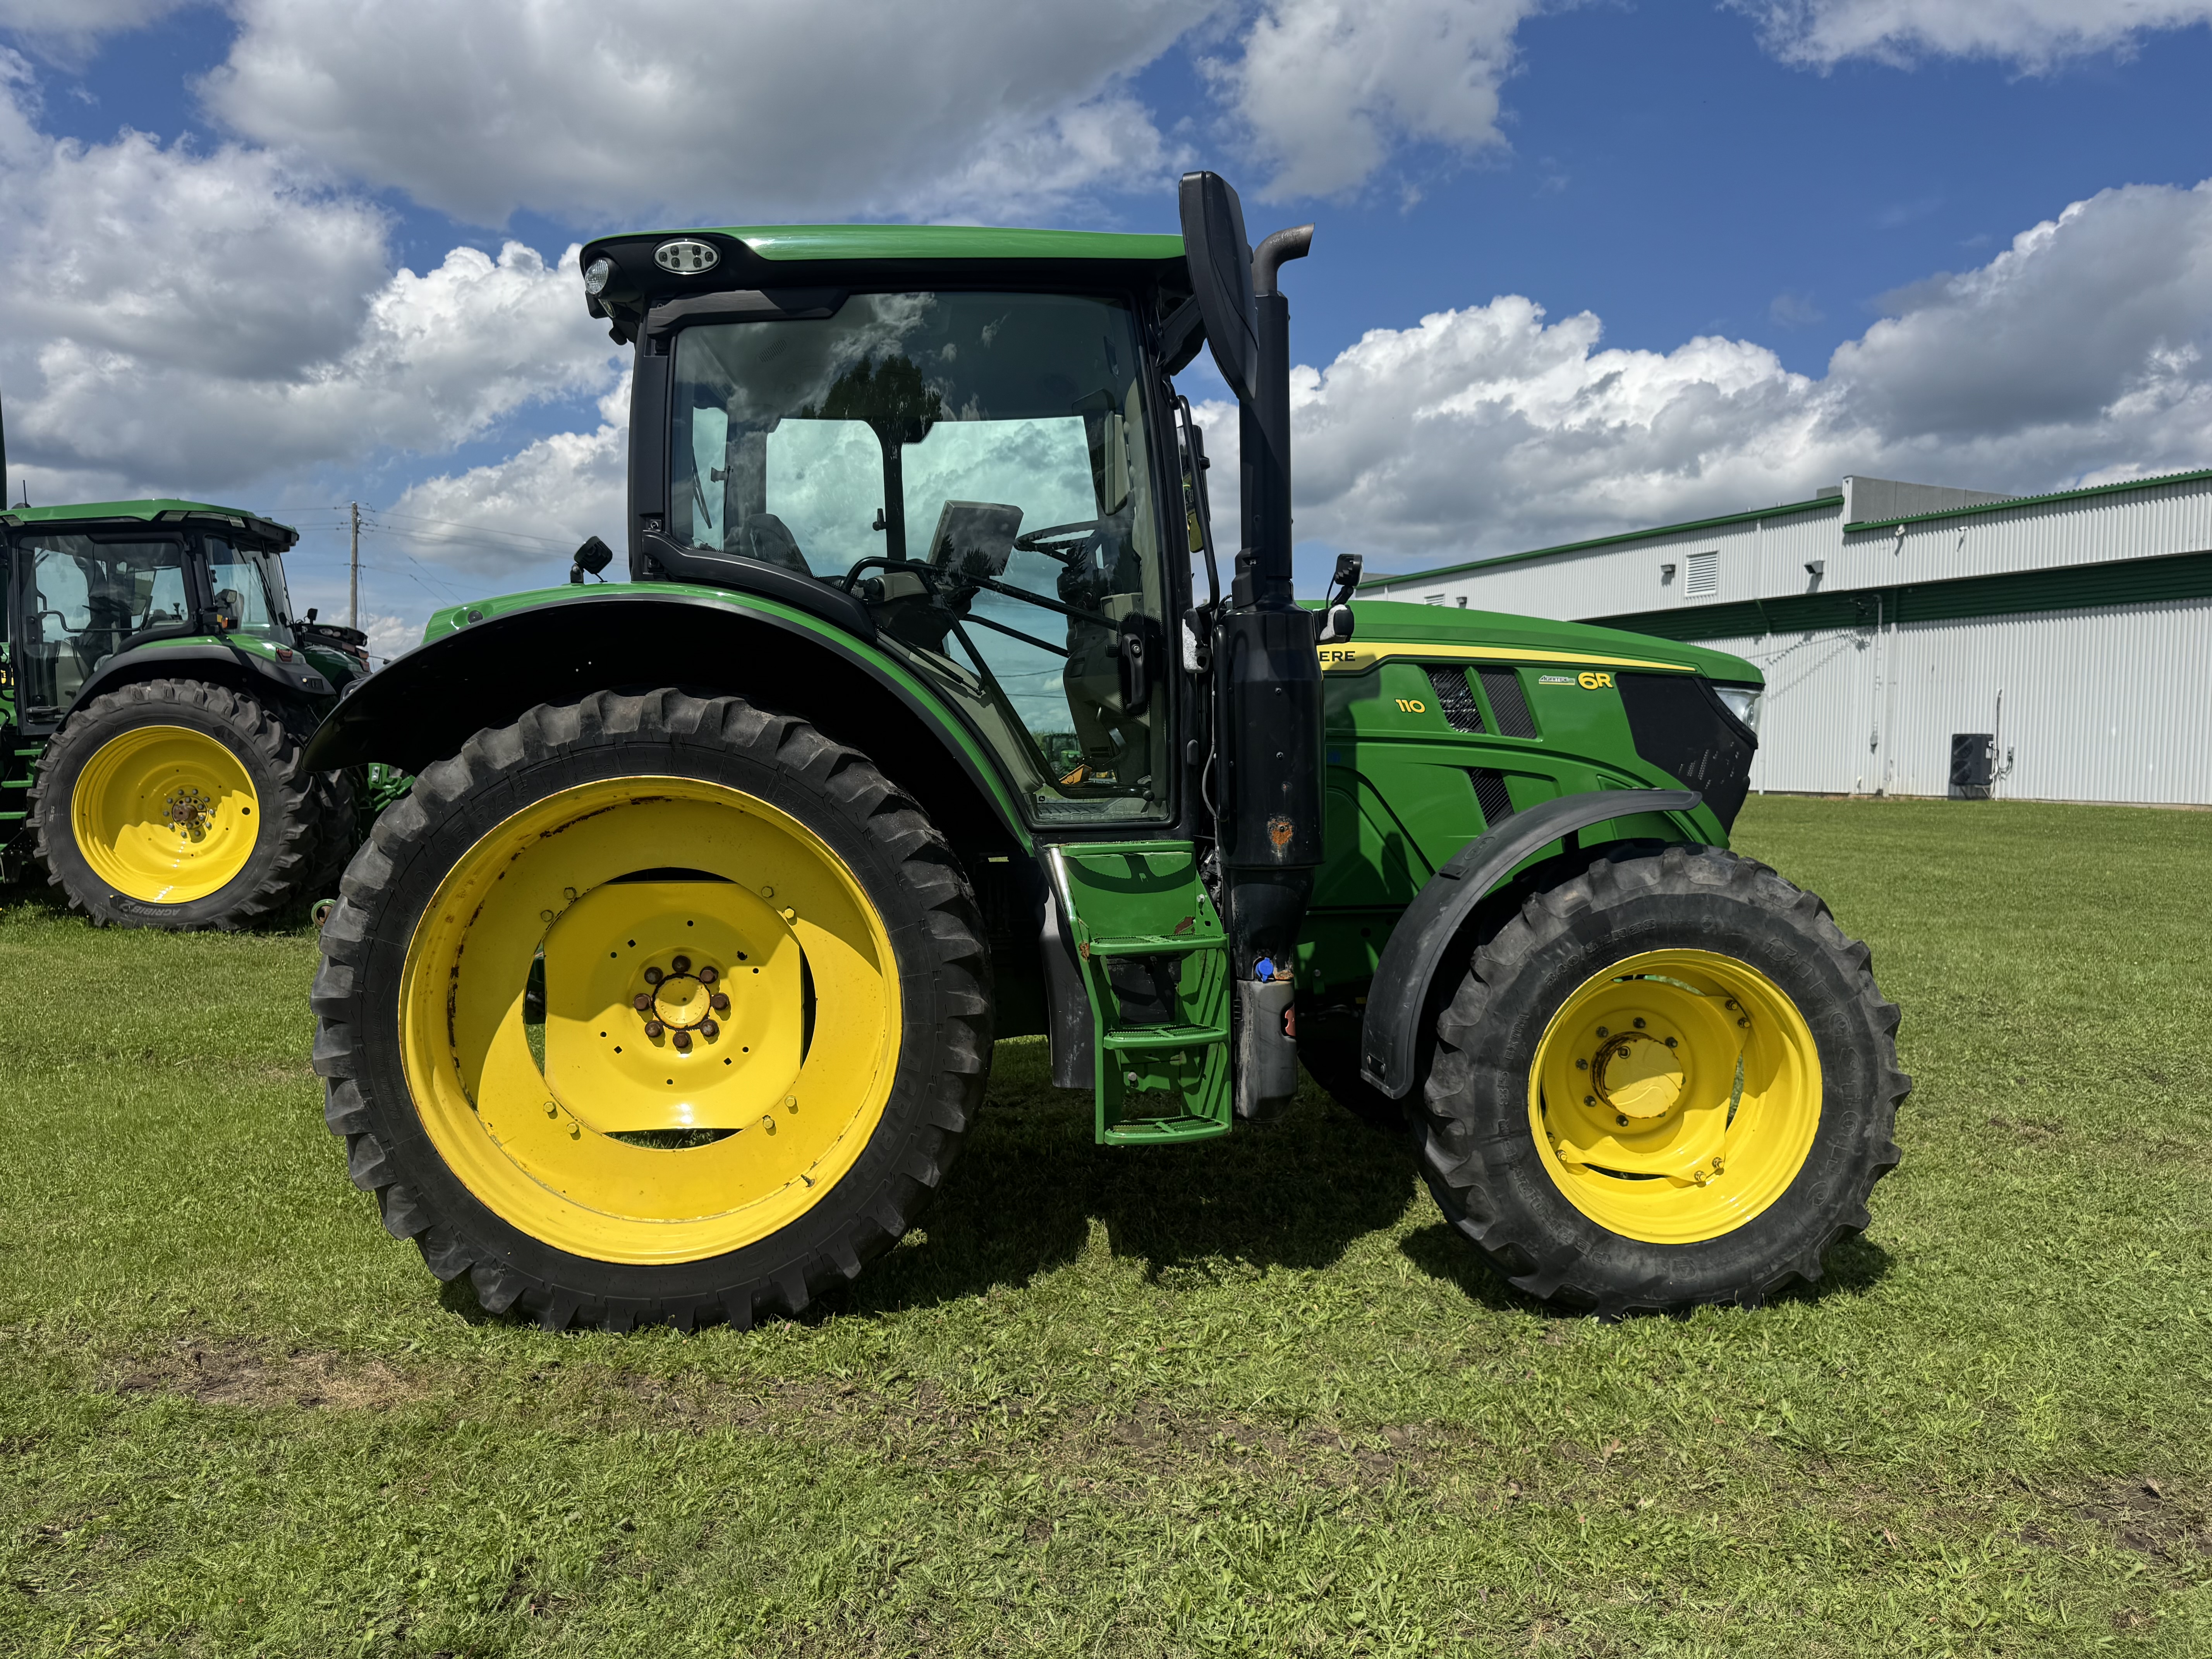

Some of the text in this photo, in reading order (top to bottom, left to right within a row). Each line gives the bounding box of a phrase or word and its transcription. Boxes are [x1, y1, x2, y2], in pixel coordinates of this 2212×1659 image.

[1578, 672, 1614, 690] 6R
[1395, 699, 1425, 713] 110
[132, 905, 181, 916] AGRIBIB
